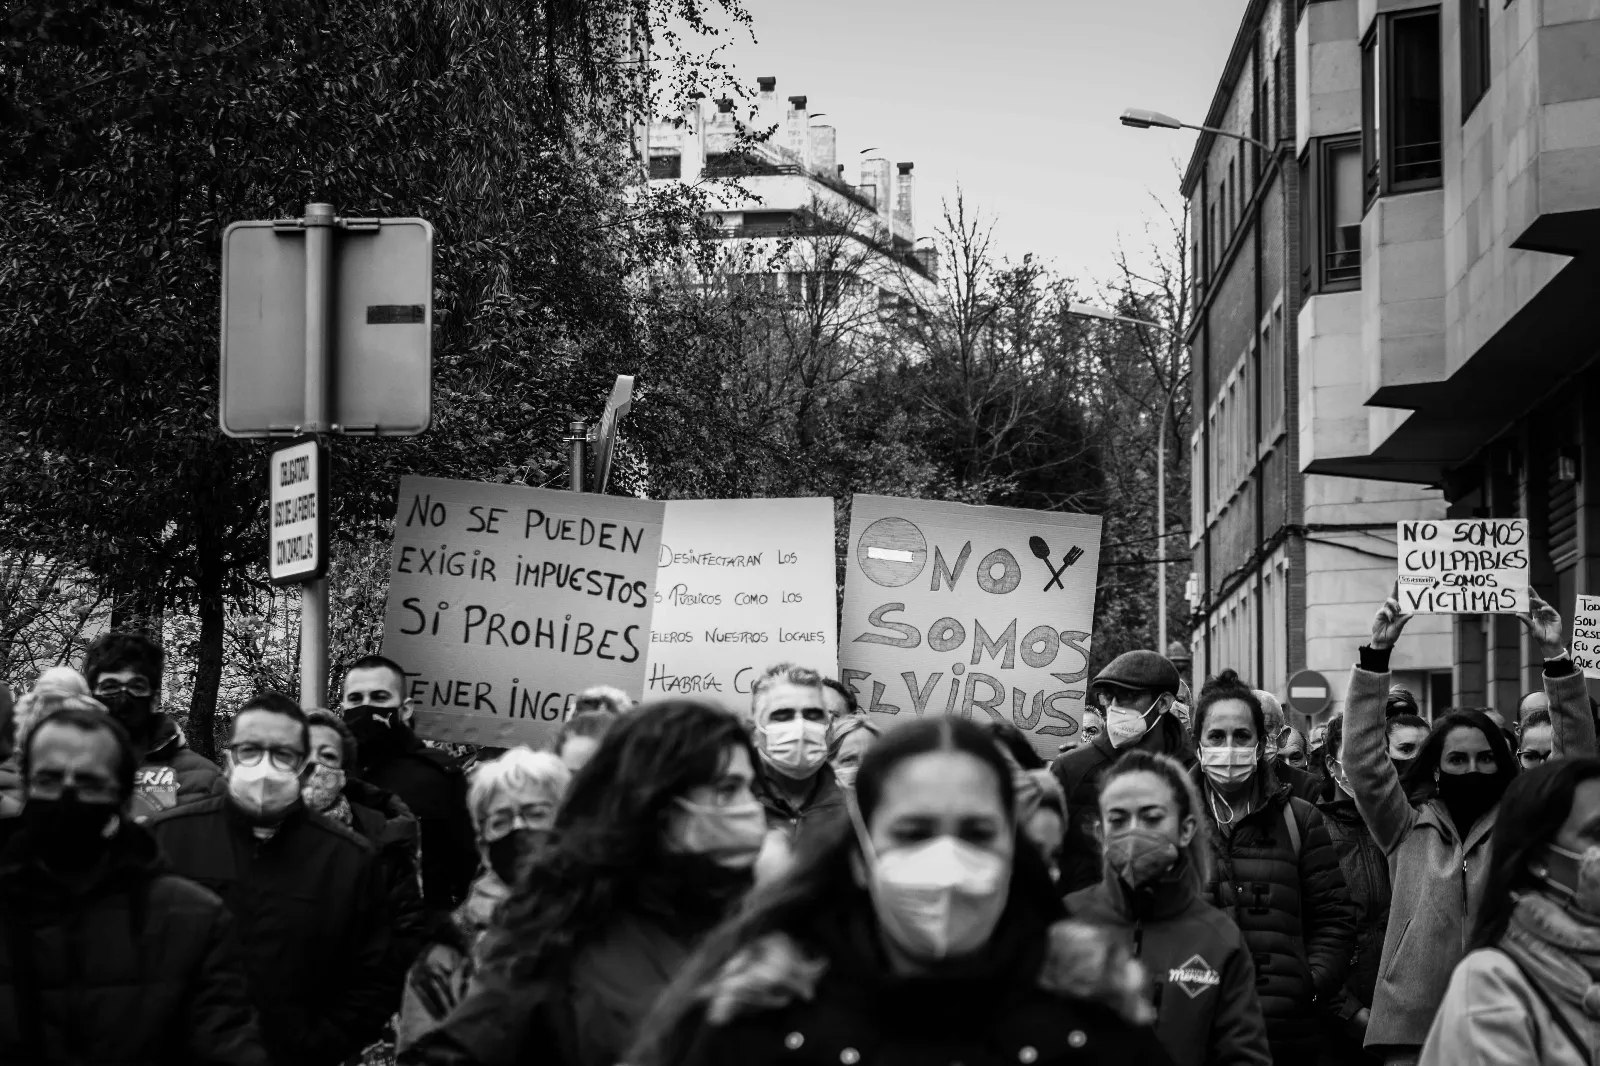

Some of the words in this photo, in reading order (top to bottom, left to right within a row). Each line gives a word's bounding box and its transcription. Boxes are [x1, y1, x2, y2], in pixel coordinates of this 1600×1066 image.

[406, 494, 447, 527] NO
[466, 506, 508, 533] SE
[525, 509, 644, 553] PUEDEN
[1403, 522, 1437, 542] NO
[1453, 521, 1524, 548] SOMOS
[930, 540, 1021, 594] NO
[1405, 549, 1528, 572] CULPABLES
[1442, 573, 1498, 587] SOMOS
[1574, 615, 1597, 626] SON
[852, 602, 1091, 684] SOMOS
